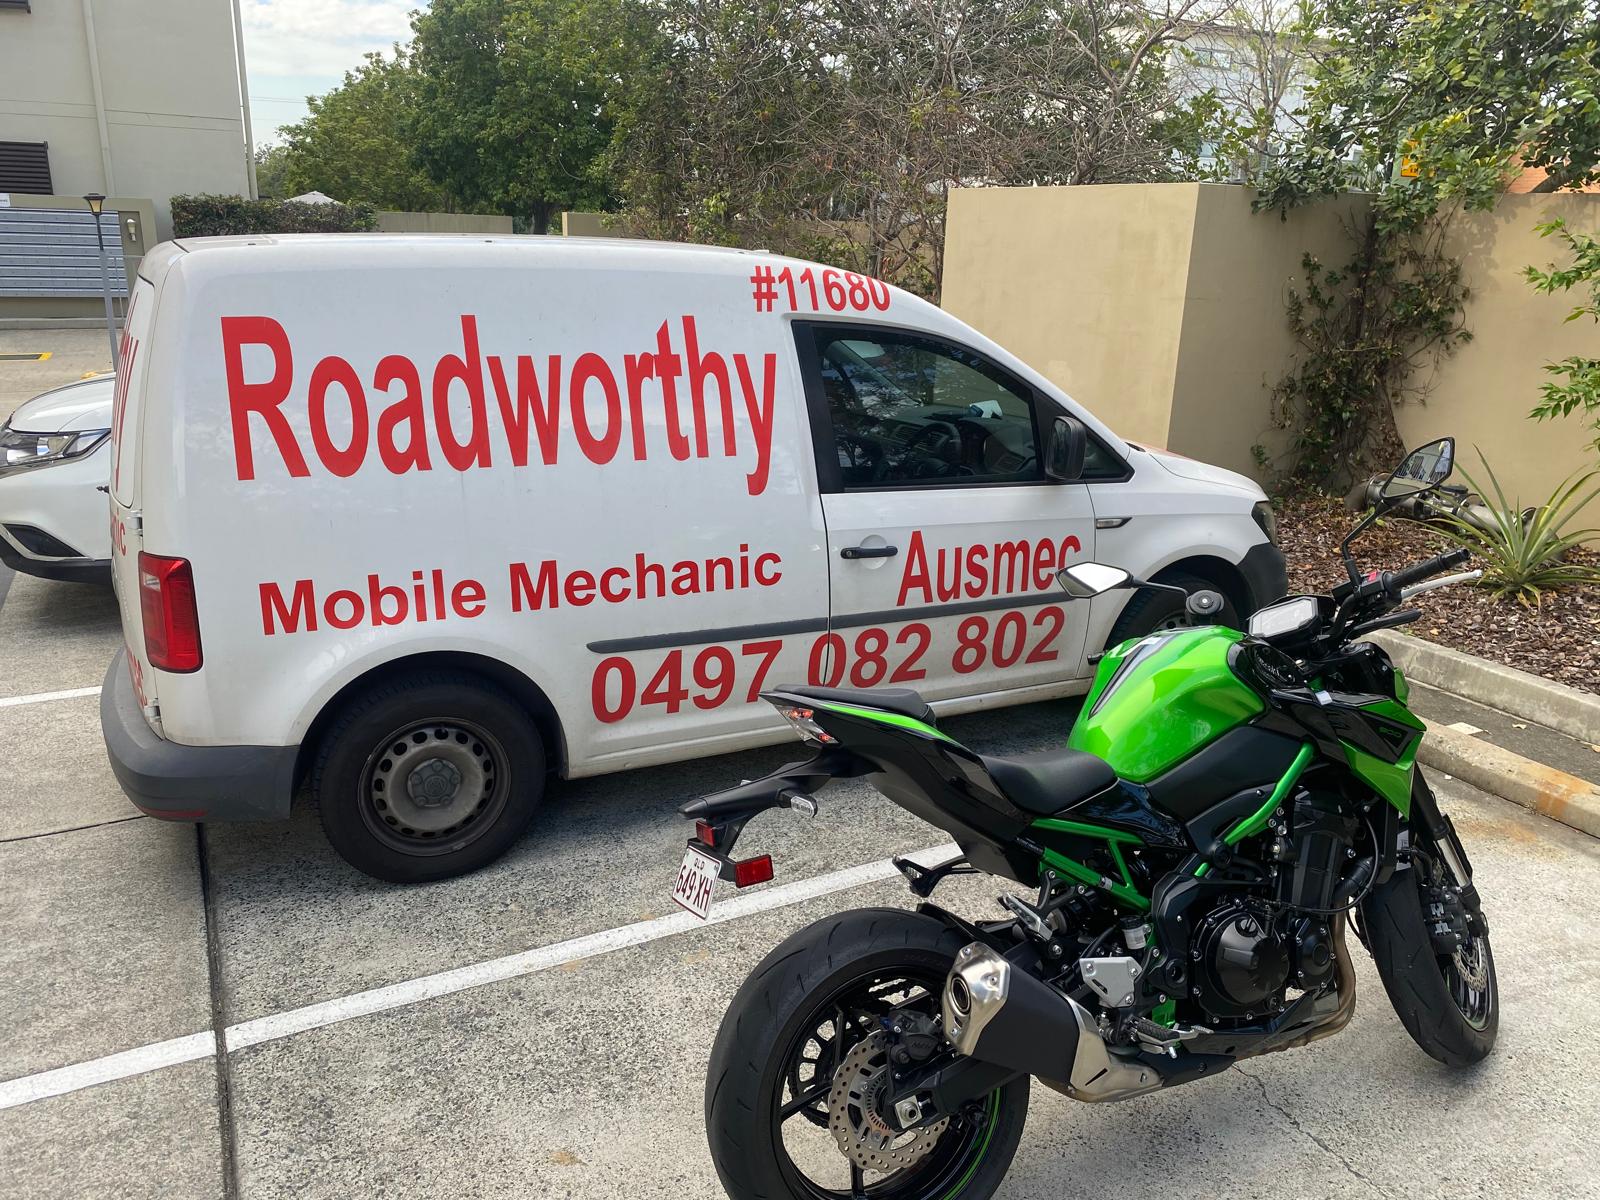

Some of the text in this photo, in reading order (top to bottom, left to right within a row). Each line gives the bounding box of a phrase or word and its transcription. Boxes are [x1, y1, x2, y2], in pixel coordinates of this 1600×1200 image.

[750, 265, 891, 312] #11680
[221, 314, 777, 497] Roadworthy
[258, 543, 782, 637] Mobile Mechanic
[897, 531, 1082, 611] Ausmec
[592, 605, 1065, 725] 0497 082 802
